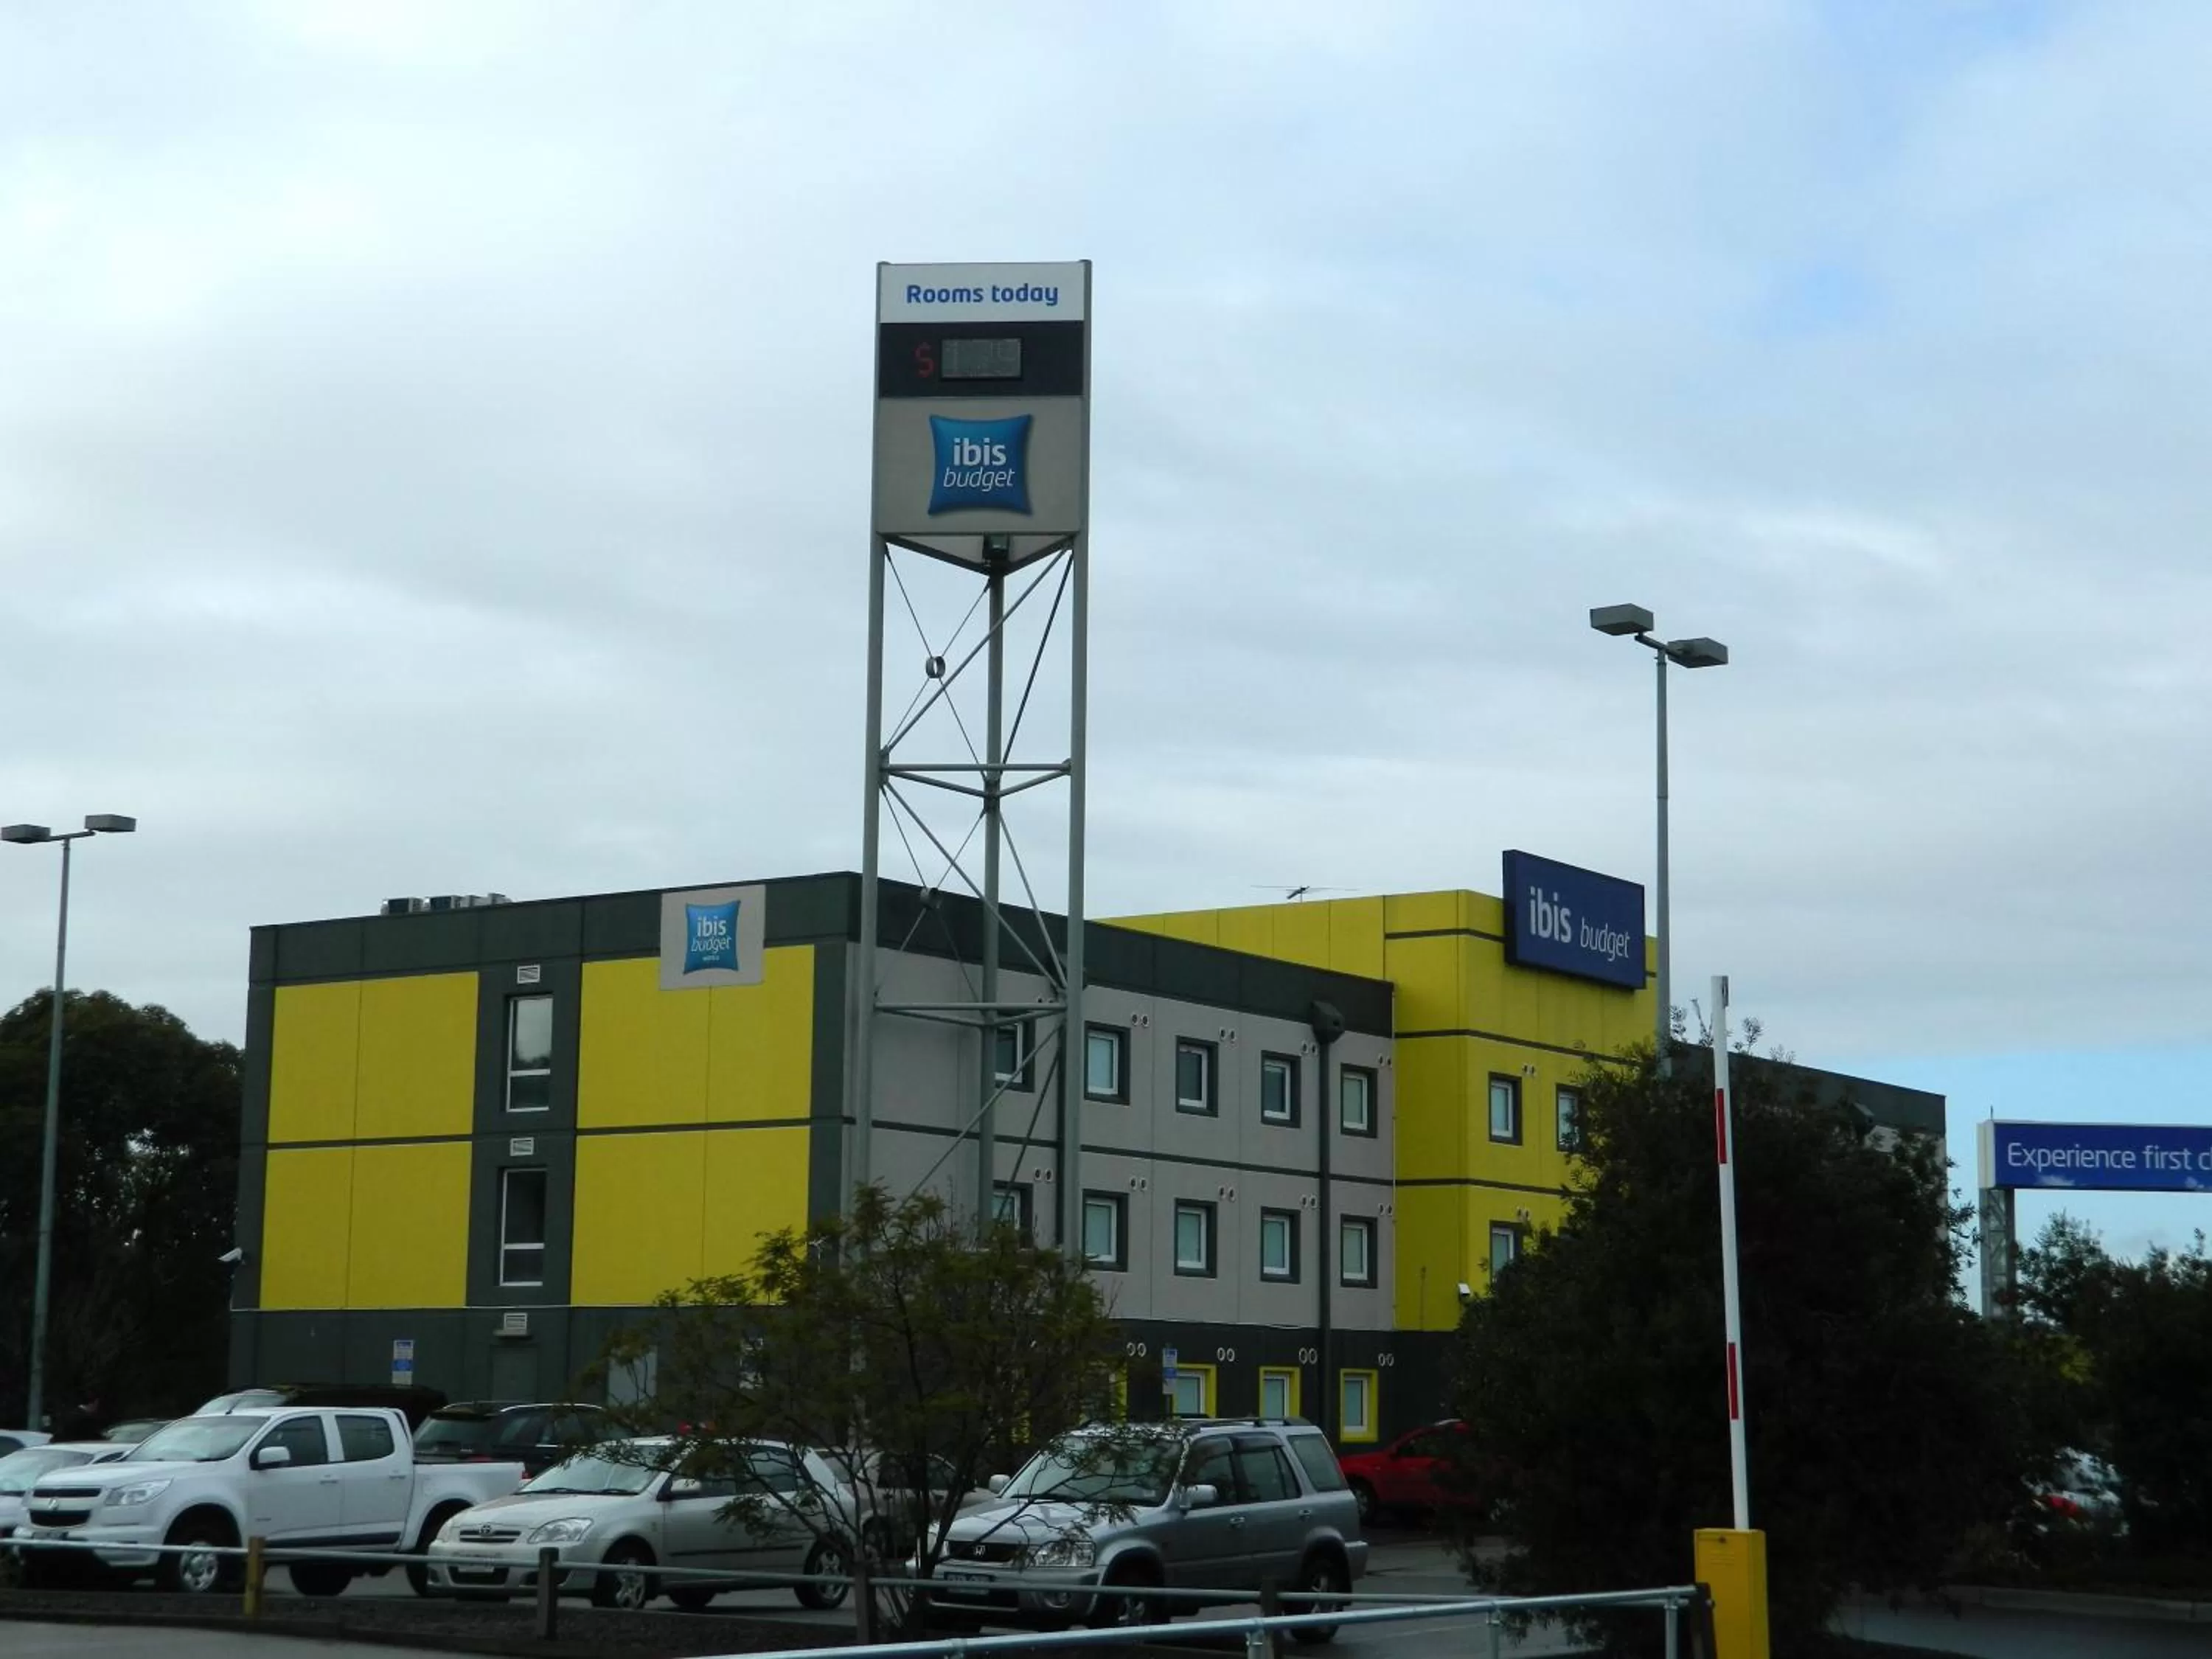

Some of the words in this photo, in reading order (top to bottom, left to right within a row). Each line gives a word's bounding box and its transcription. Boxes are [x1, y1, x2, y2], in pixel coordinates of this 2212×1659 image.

[906, 285, 984, 304] Rooms
[992, 283, 1058, 306] today
[953, 438, 1006, 466] ibis
[943, 467, 1015, 492] budget
[697, 916, 727, 937] ibis
[1530, 886, 1571, 943] ibis
[1580, 917, 1630, 961] budget
[691, 934, 731, 953] budget
[2008, 1143, 2135, 1172] Experience
[2142, 1145, 2192, 1171] first
